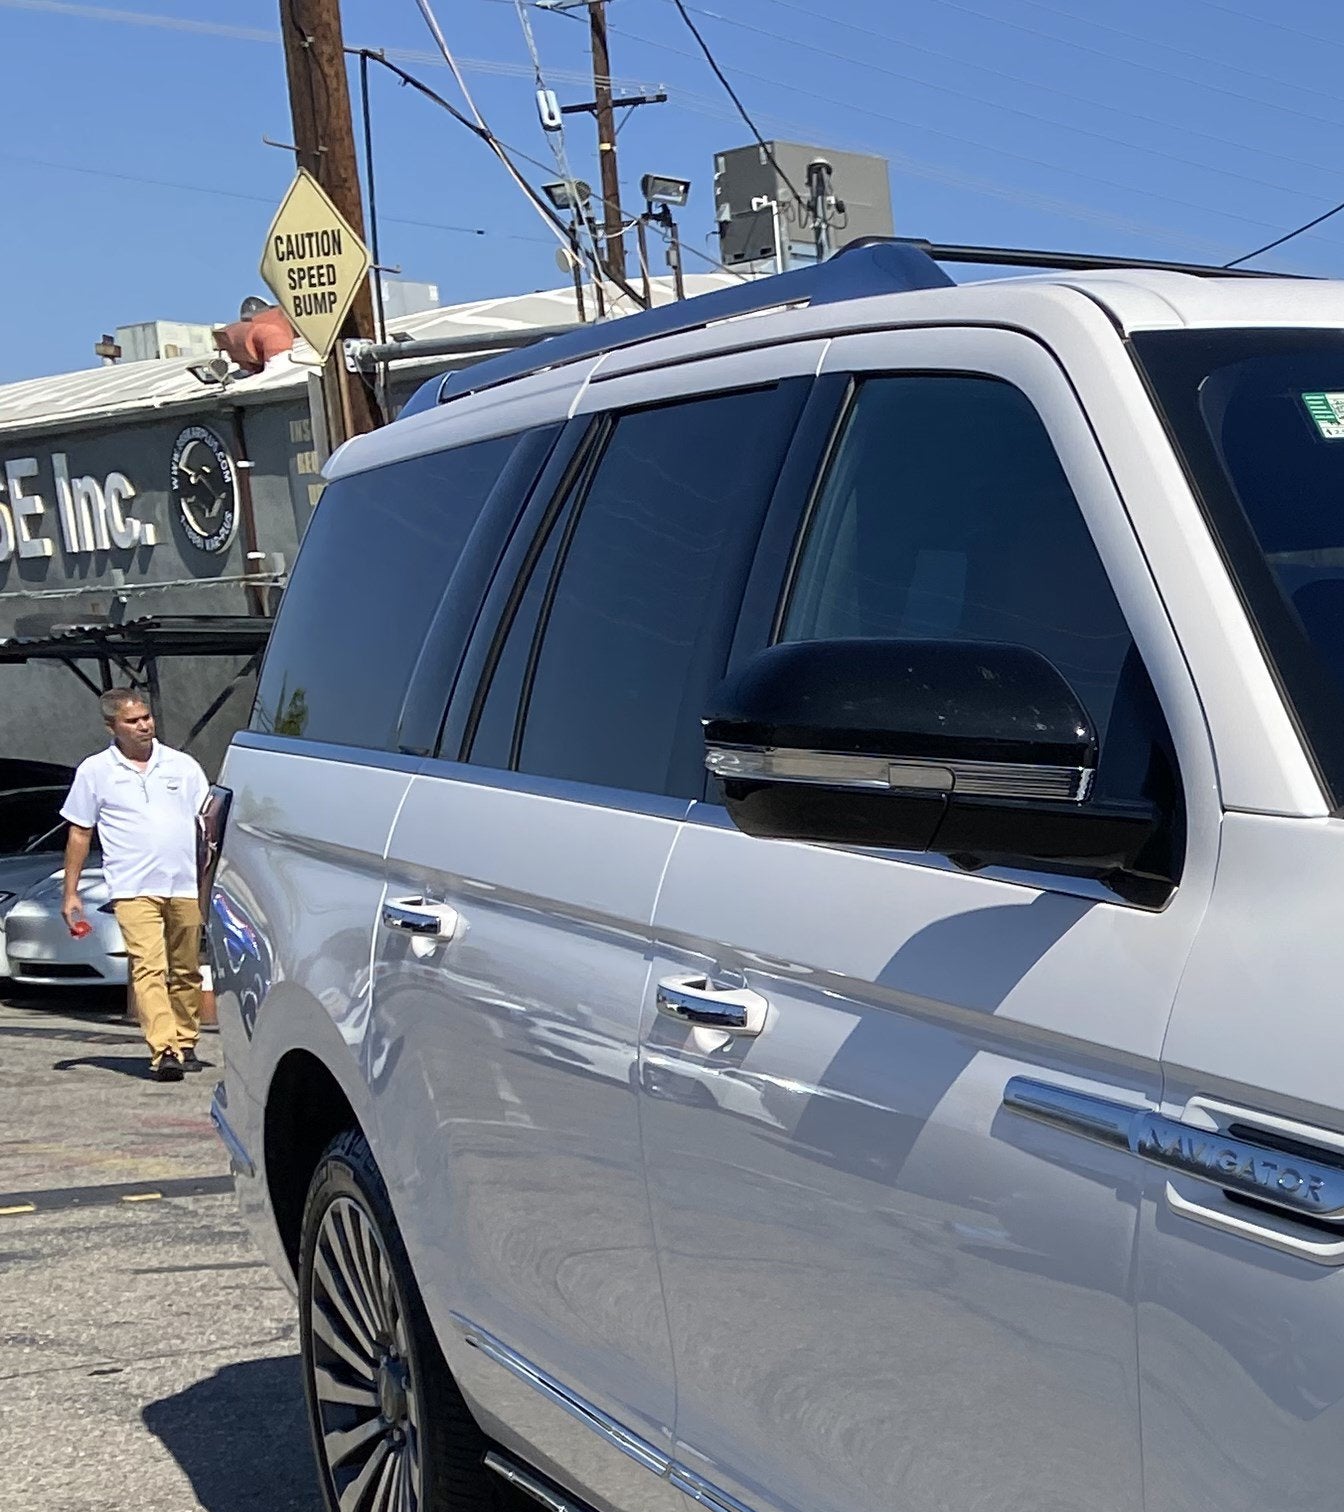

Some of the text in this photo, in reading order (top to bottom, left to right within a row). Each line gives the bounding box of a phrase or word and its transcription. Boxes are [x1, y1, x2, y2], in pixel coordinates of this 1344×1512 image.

[273, 228, 343, 262] CAUTION
[287, 263, 337, 291] SPEED
[292, 291, 338, 318] BUMP
[51, 452, 156, 553] Inc.
[1137, 1128, 1326, 1202] NAVIGATOR
